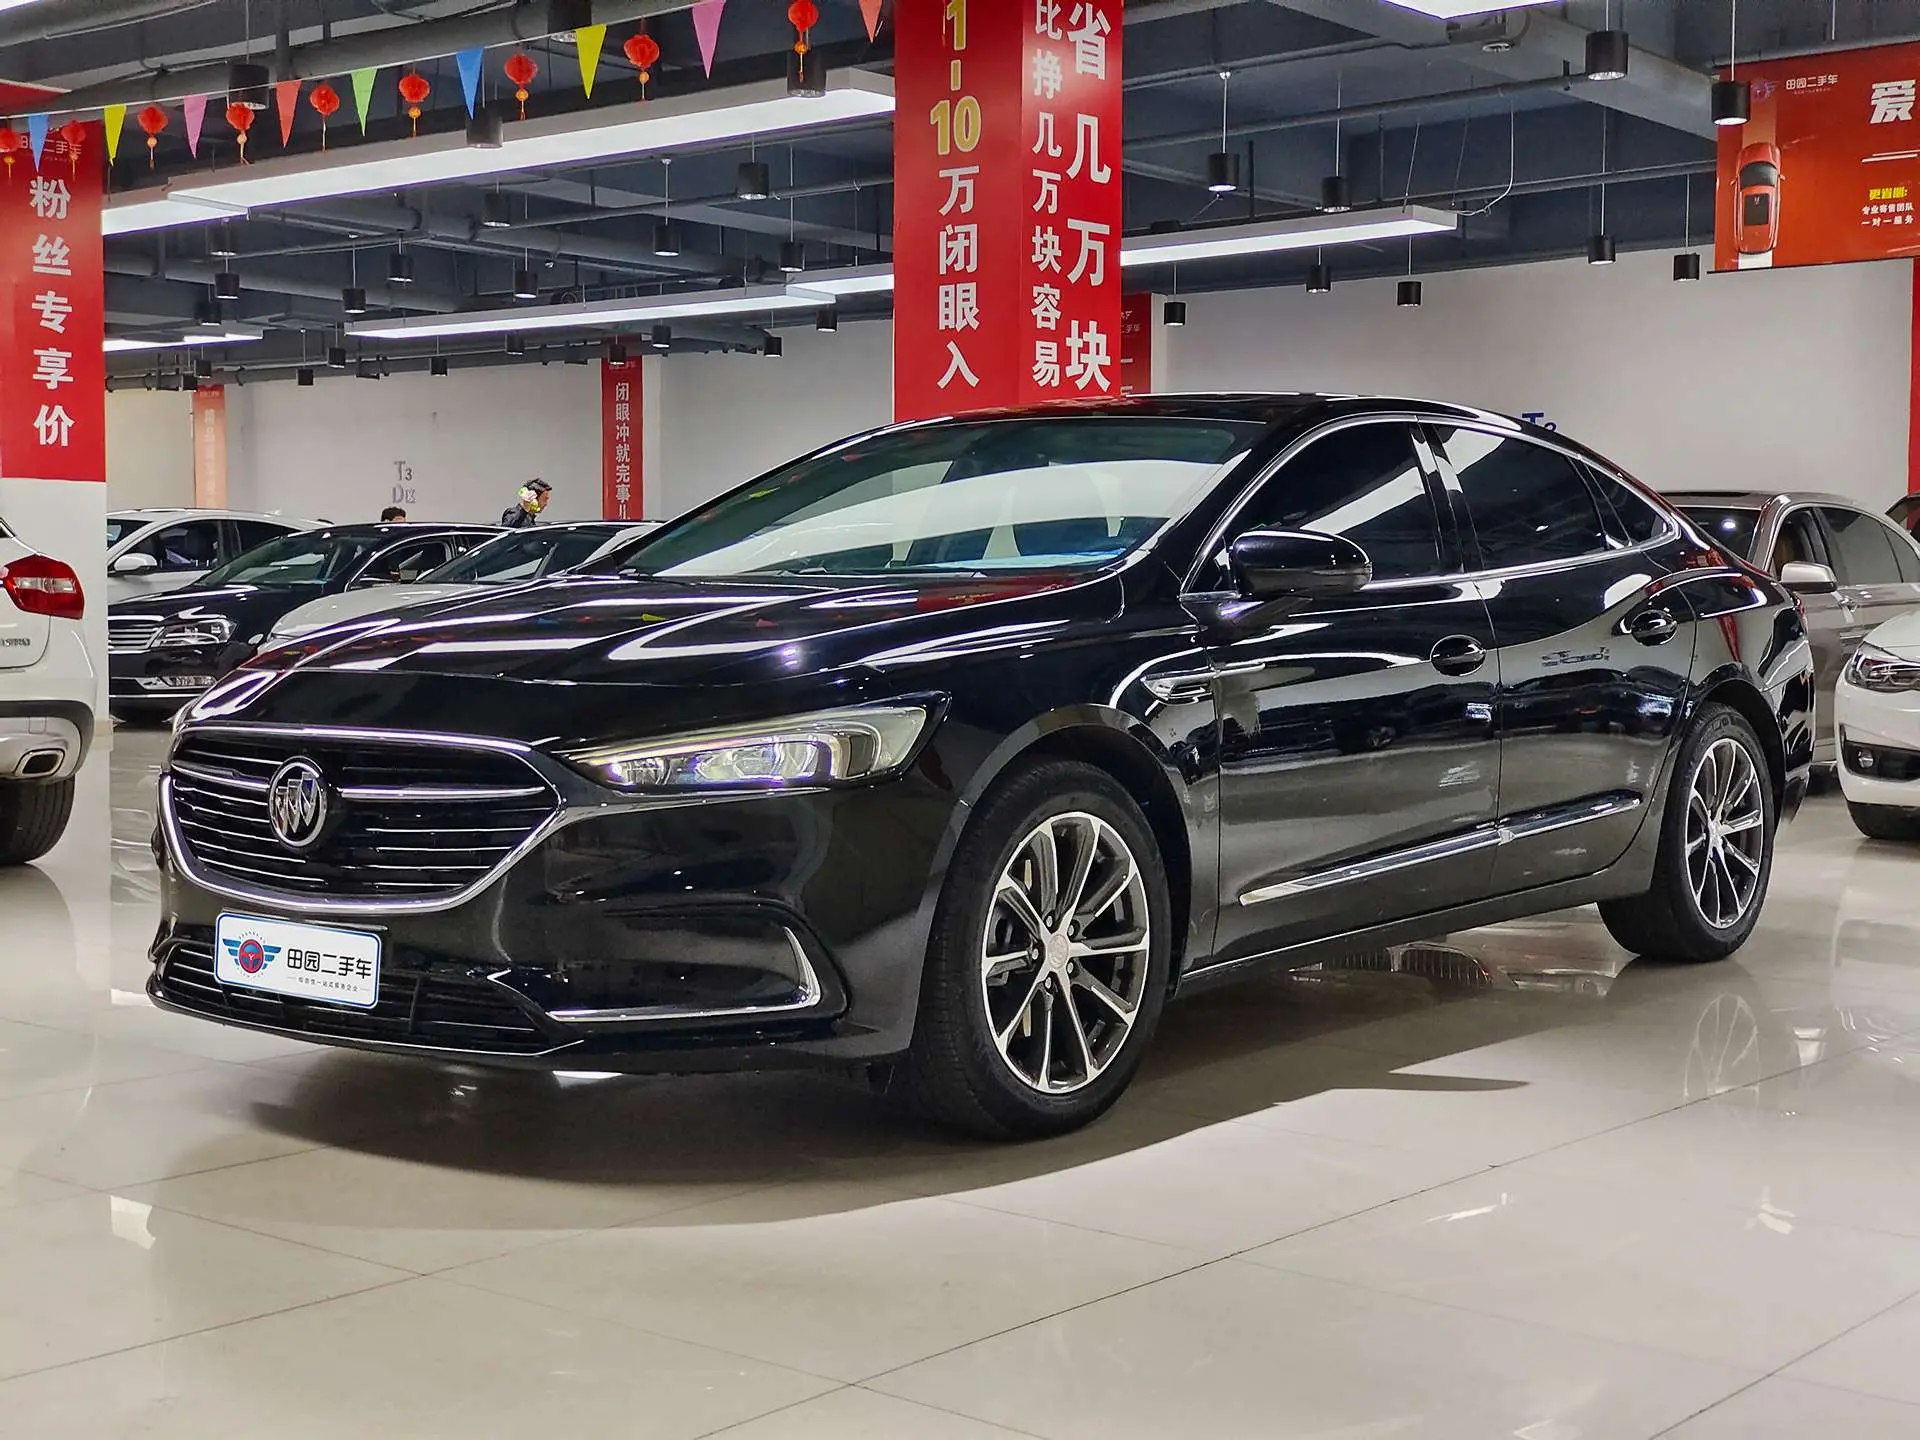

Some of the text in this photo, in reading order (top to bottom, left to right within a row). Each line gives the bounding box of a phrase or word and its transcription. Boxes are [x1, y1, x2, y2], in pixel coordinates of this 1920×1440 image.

[1785, 74, 1839, 90] 田园二手车
[1869, 79, 1917, 124] 爱
[1031, 0, 1063, 388] 比挣几万块容易
[1066, 2, 1112, 392] 省几万块
[30, 176, 75, 447] 粉丝专享价
[393, 460, 413, 481] T3
[287, 948, 372, 979] 田园二手车
